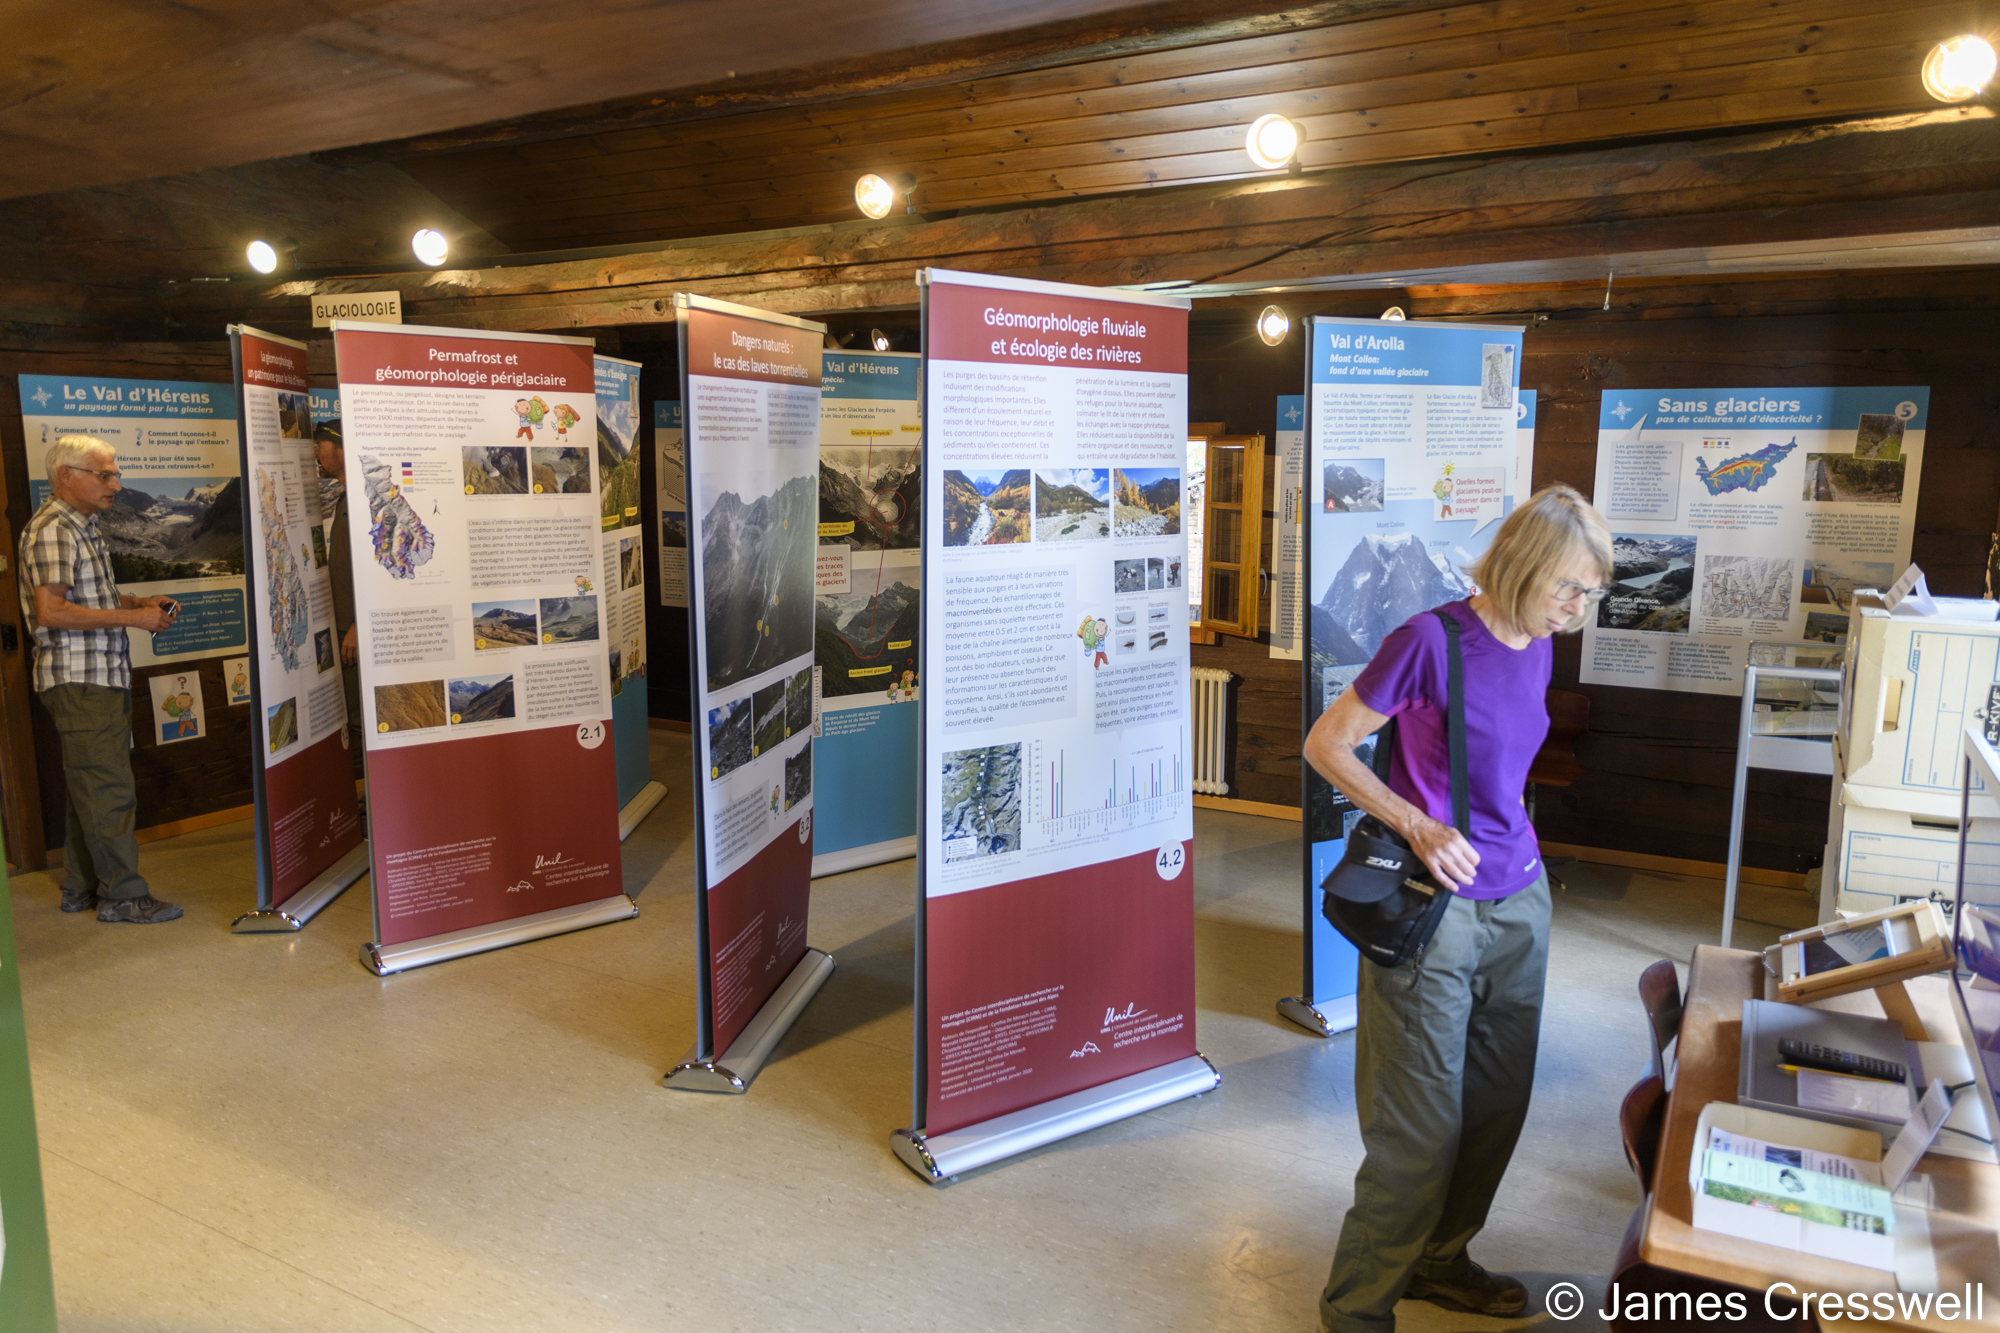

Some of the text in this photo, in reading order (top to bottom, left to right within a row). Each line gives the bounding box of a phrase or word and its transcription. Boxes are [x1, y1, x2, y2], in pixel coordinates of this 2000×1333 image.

[316, 301, 396, 318] GLACIOLOGIE
[984, 307, 1146, 338] Géomorphologie fluviale
[731, 330, 790, 354] Dangers naturels
[1330, 334, 1405, 350] Val d'Arolla
[429, 348, 518, 365] Permafrost et
[991, 338, 1141, 363] et écologie des rivières
[1329, 353, 1380, 363] Mont Collon:
[713, 352, 808, 378] le cas des laves torrentielles
[826, 361, 899, 374] Val d'Hérens
[1329, 365, 1429, 378] fond d'une vallée glaciaire
[375, 366, 566, 387] géomorphologie périglaciaire
[943, 370, 954, 378] Les
[955, 372, 976, 380] purges
[989, 372, 1010, 380] bassins
[63, 384, 209, 404] Le Val d'Hérens
[78, 404, 118, 412] paysage
[120, 403, 146, 411] formé
[180, 405, 213, 414] glaciers
[1658, 396, 1800, 416] Sans glaciers
[1900, 404, 1912, 418] 5
[1692, 414, 1733, 423] cultures
[1749, 414, 1813, 423] d'électricité
[179, 430, 216, 439] façonne-t-il
[1455, 487, 1502, 496] glaciaires peut-on
[1456, 505, 1480, 514] paysage?
[822, 578, 846, 586] glaciers!
[955, 575, 974, 583] faune
[975, 574, 1005, 582] aquatique
[1006, 572, 1023, 580] réagit
[945, 607, 1002, 617] macroinvertébrés
[580, 726, 600, 740] 2.1
[801, 816, 809, 835] 3.2
[535, 852, 575, 869] Unil
[1159, 849, 1181, 868] 4.2
[1365, 856, 1402, 870] 2XU
[546, 878, 570, 887] recherche
[585, 870, 610, 880] montagne
[564, 864, 602, 878] interdisciplinaire
[1104, 1002, 1148, 1026] Unil
[1114, 1013, 1184, 1040] Centre interdisciplinaire de
[1114, 1022, 1184, 1048] recherche sur la montagne
